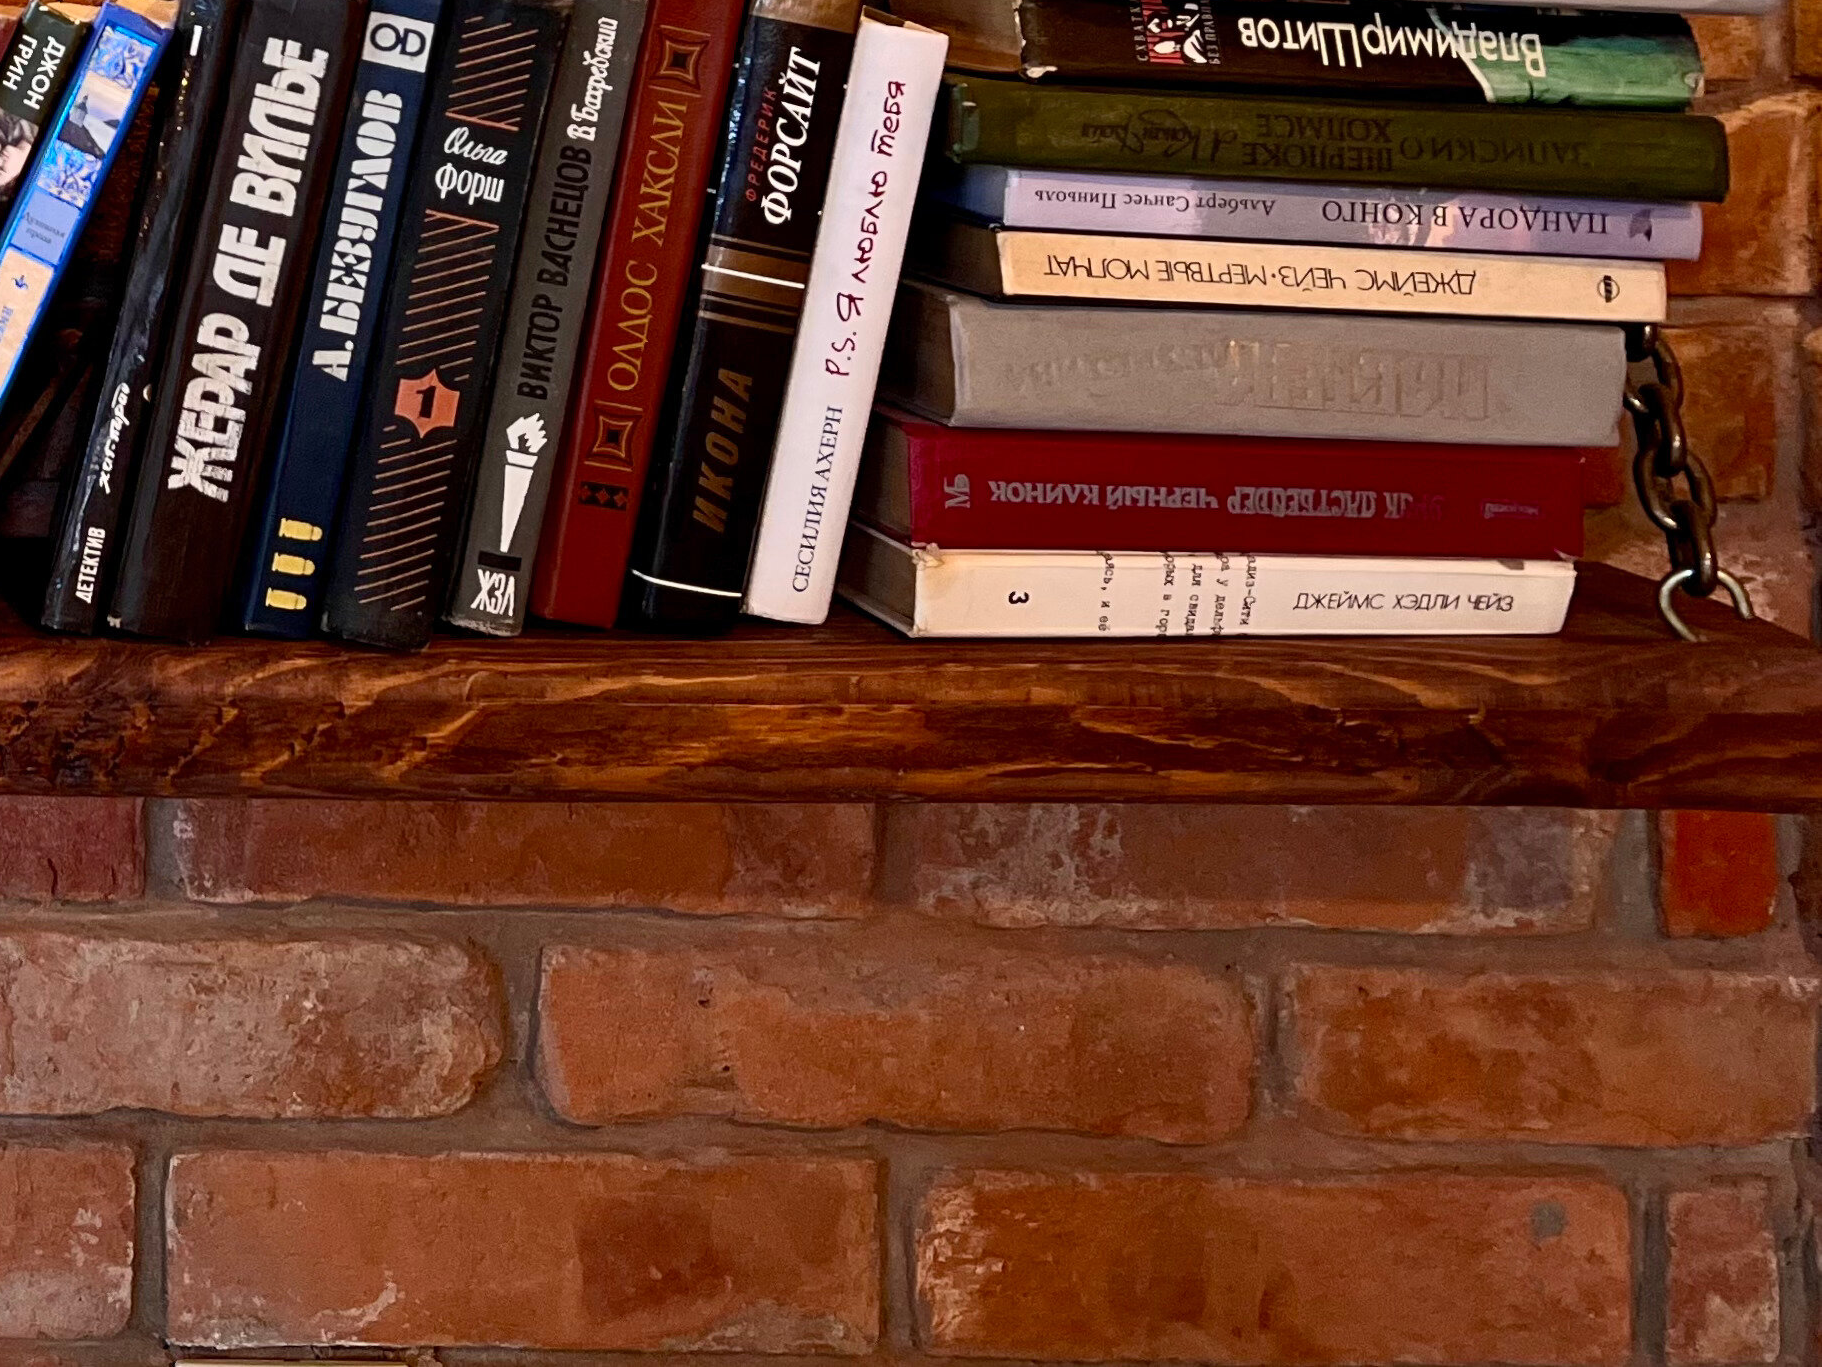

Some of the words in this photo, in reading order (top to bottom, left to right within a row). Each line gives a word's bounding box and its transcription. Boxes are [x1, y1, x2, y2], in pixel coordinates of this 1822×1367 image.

[2, 33, 38, 91] ГРИН
[22, 35, 67, 110] ДЖОН
[1208, 44, 1221, 66] БЕЗ
[229, 36, 330, 217] ВИЛЬЕ
[444, 126, 509, 167] Ольга
[745, 86, 777, 203] ФРЕДЕРИК
[762, 46, 822, 227] ФОРСАЙТ
[1256, 113, 1394, 143] ХОЛМСЕ
[631, 100, 688, 247] ХАКСЛИ
[1242, 142, 1394, 172] ШЕРЛОКЕ
[537, 145, 592, 287] ВАСНЕЦОВ
[835, 290, 865, 323] Я
[852, 170, 888, 284] люблю
[872, 79, 907, 157] тебя
[1034, 187, 1118, 211] Пиньоль
[1123, 191, 1191, 213] Санчес
[1195, 196, 1277, 218] Альберт
[1322, 200, 1422, 226] КОНГО
[1432, 204, 1448, 227] В
[1462, 205, 1608, 235] ПАНДОРА
[212, 224, 287, 307] ДЕ
[1043, 254, 1149, 282] МОЛЧАТ
[1356, 268, 1477, 297] ДЖЕЙМС
[517, 293, 564, 400] ВИКТОР
[607, 260, 658, 392] ОЛДОС
[167, 311, 261, 503] ЖЕРАР
[415, 384, 438, 420] 1
[692, 367, 755, 534] ИКОНА
[792, 486, 825, 594] СЕСИЛИЯ
[814, 405, 844, 483] АХЕРН
[987, 480, 1100, 506] КЛИНОК
[1106, 484, 1219, 511] ЧЕРНЫЙ
[75, 526, 106, 604] ДЕТЕКТИВ
[1097, 550, 1115, 591] аясь,
[1158, 552, 1176, 587] орых
[1216, 578, 1228, 588] у
[470, 568, 515, 617] ЖЗЛ
[1007, 590, 1029, 605] 3
[1292, 590, 1385, 610] ДЖЕЙМС
[1391, 593, 1461, 611] ХЭДЛИ
[1467, 591, 1515, 612] ЧЕЙЗ
[1184, 594, 1200, 635] свида
[1210, 594, 1226, 635] дельф
